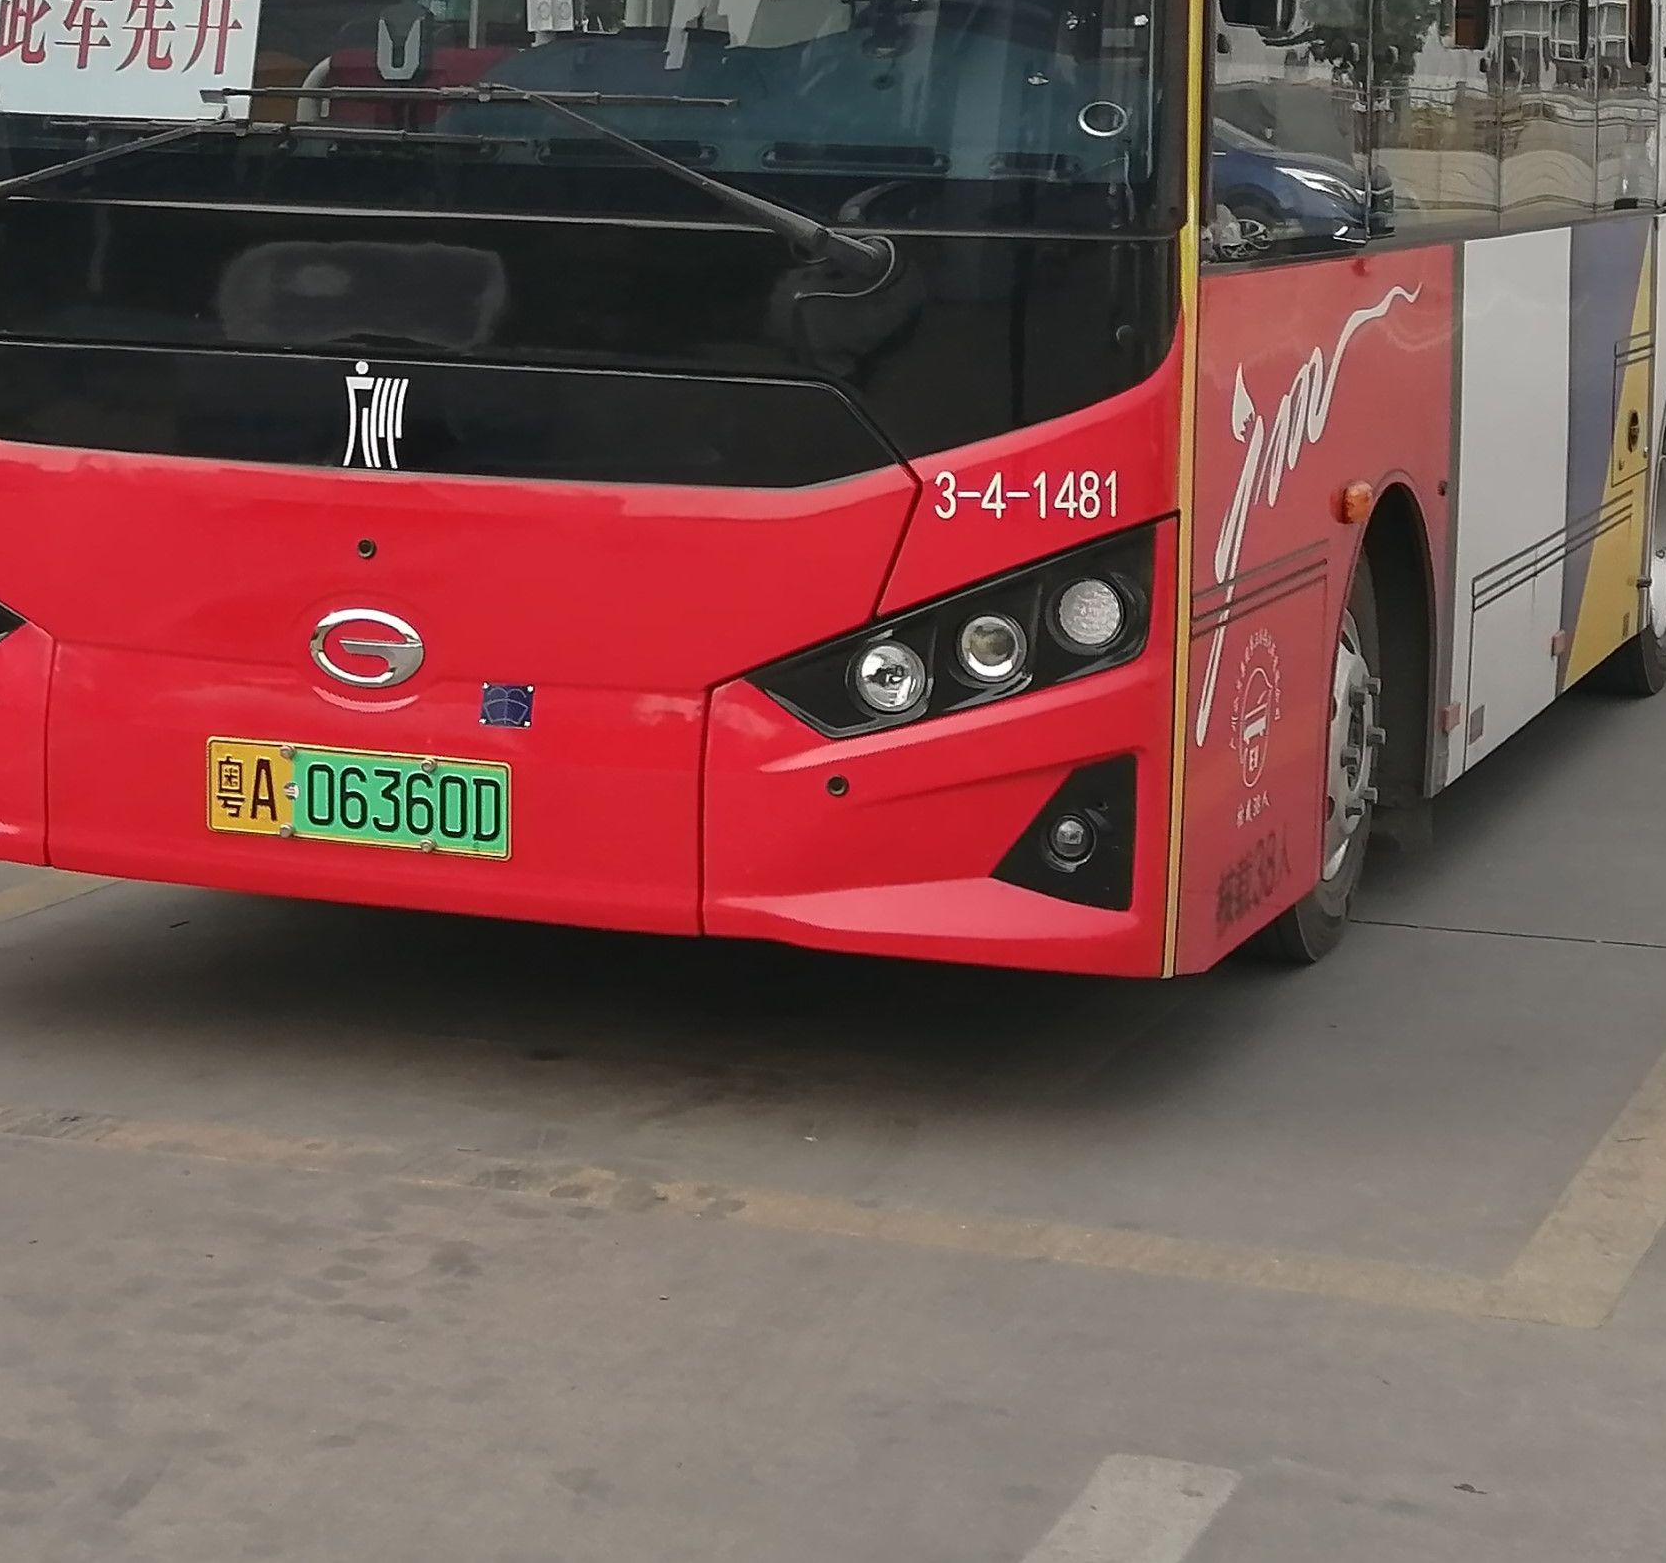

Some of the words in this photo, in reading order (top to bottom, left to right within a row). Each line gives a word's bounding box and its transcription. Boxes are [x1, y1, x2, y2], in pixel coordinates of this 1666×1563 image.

[933, 469, 1119, 520] 3-4-1481
[215, 754, 278, 822] 粤A
[306, 762, 503, 842] 06360D
